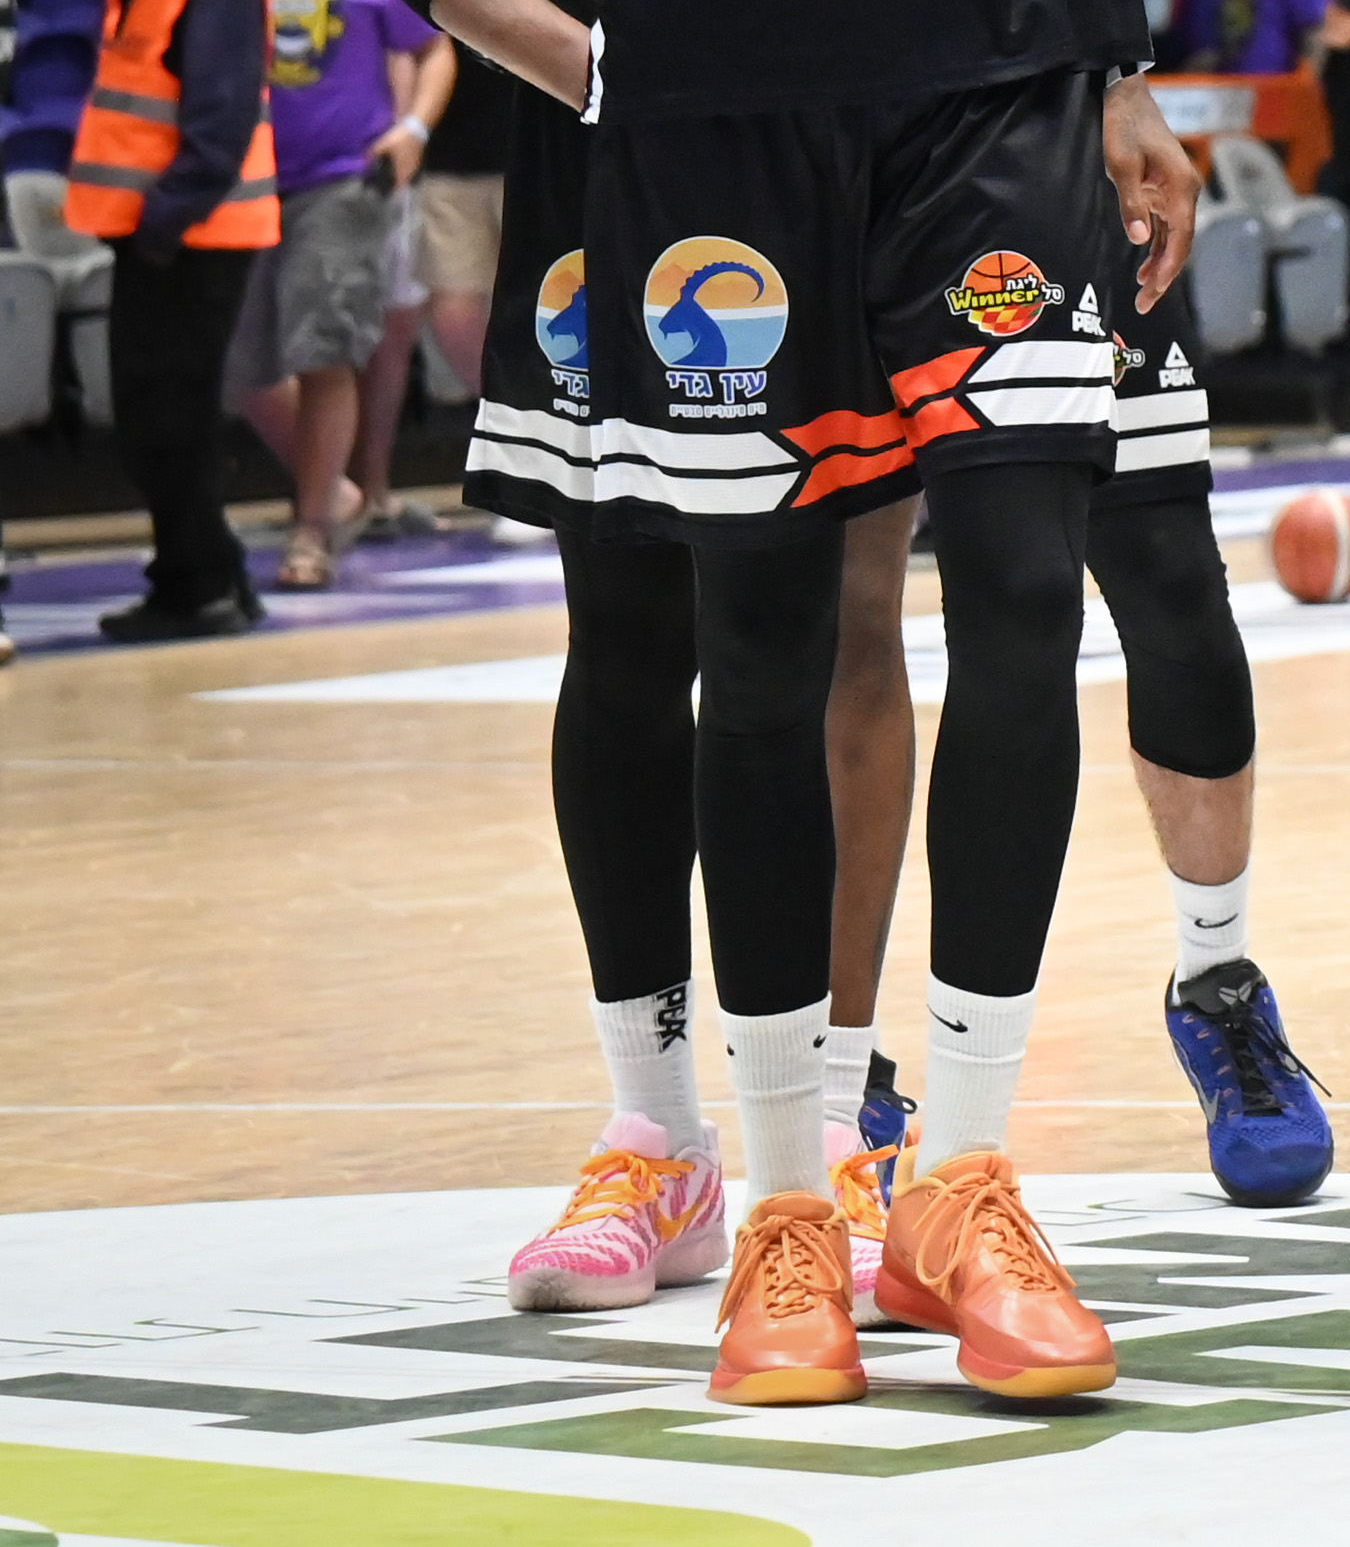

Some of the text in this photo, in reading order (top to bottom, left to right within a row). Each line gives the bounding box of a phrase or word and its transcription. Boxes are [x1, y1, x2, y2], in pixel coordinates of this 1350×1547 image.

[1006, 273, 1037, 291] ליגת
[950, 283, 1062, 311] Winner סל
[665, 371, 767, 403] עין גדי
[1159, 367, 1196, 388] PEAK
